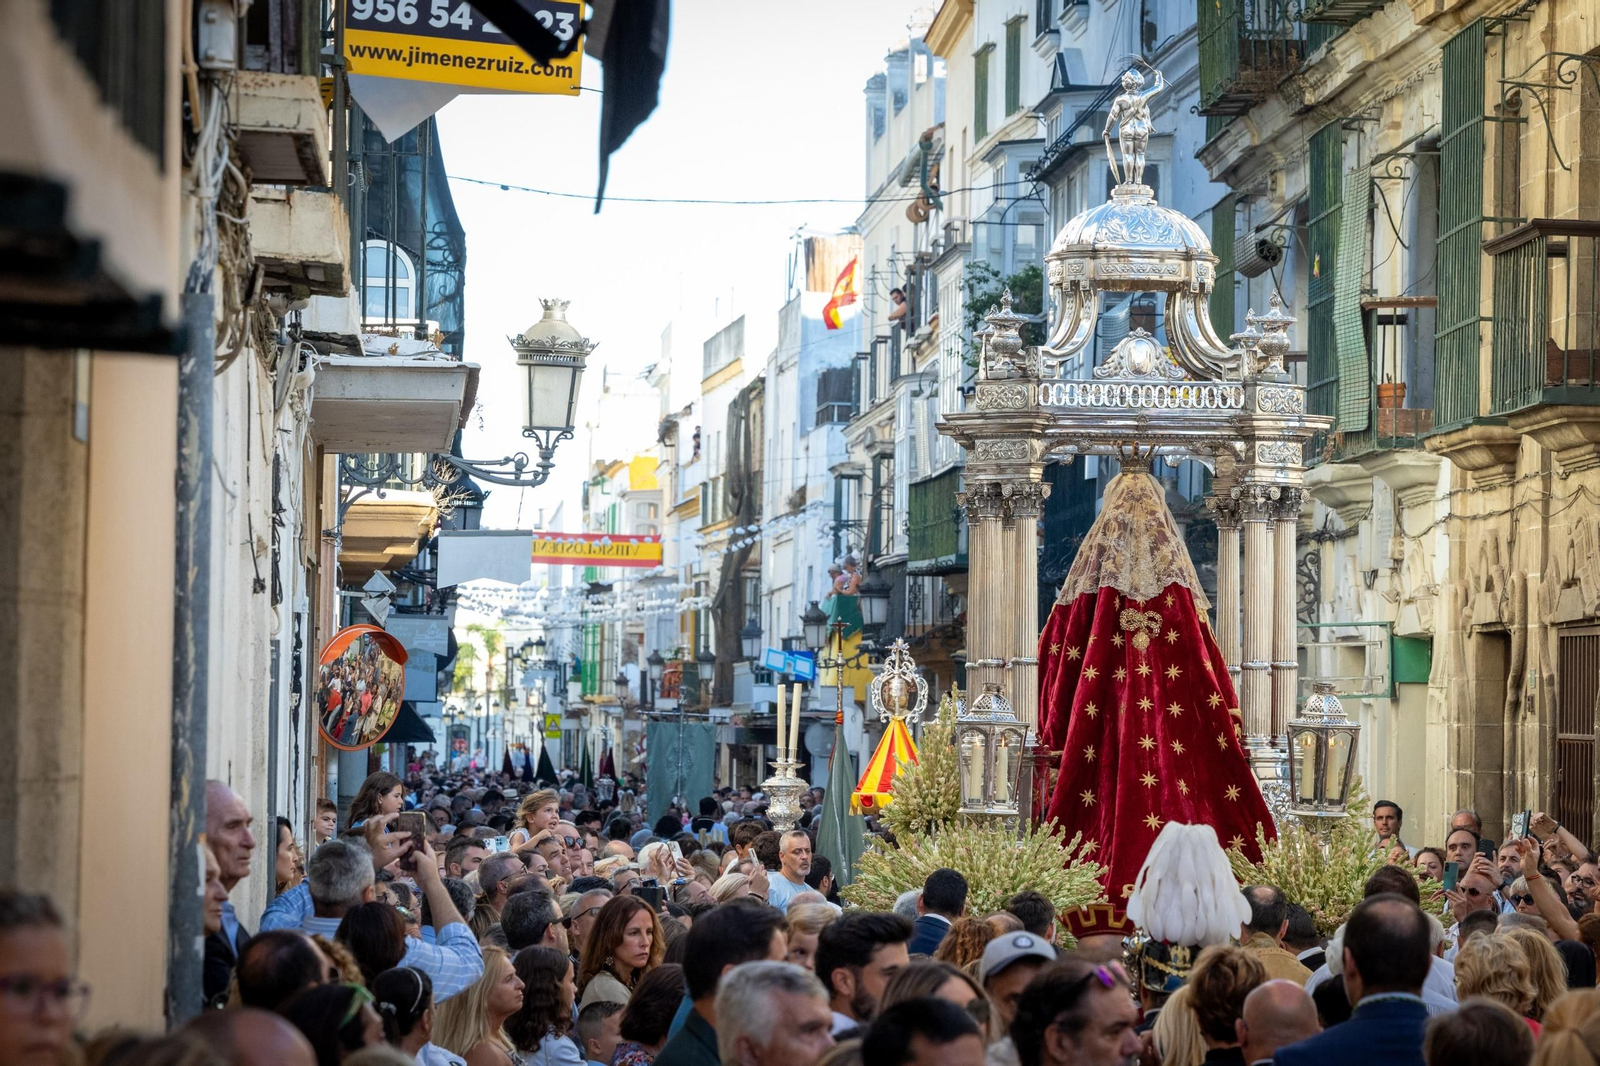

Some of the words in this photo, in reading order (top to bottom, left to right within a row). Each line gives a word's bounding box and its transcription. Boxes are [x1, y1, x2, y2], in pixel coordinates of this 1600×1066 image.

[352, 0, 418, 25] 956
[428, 0, 473, 31] 54
[349, 44, 573, 78] www.jimenezruiz.com
